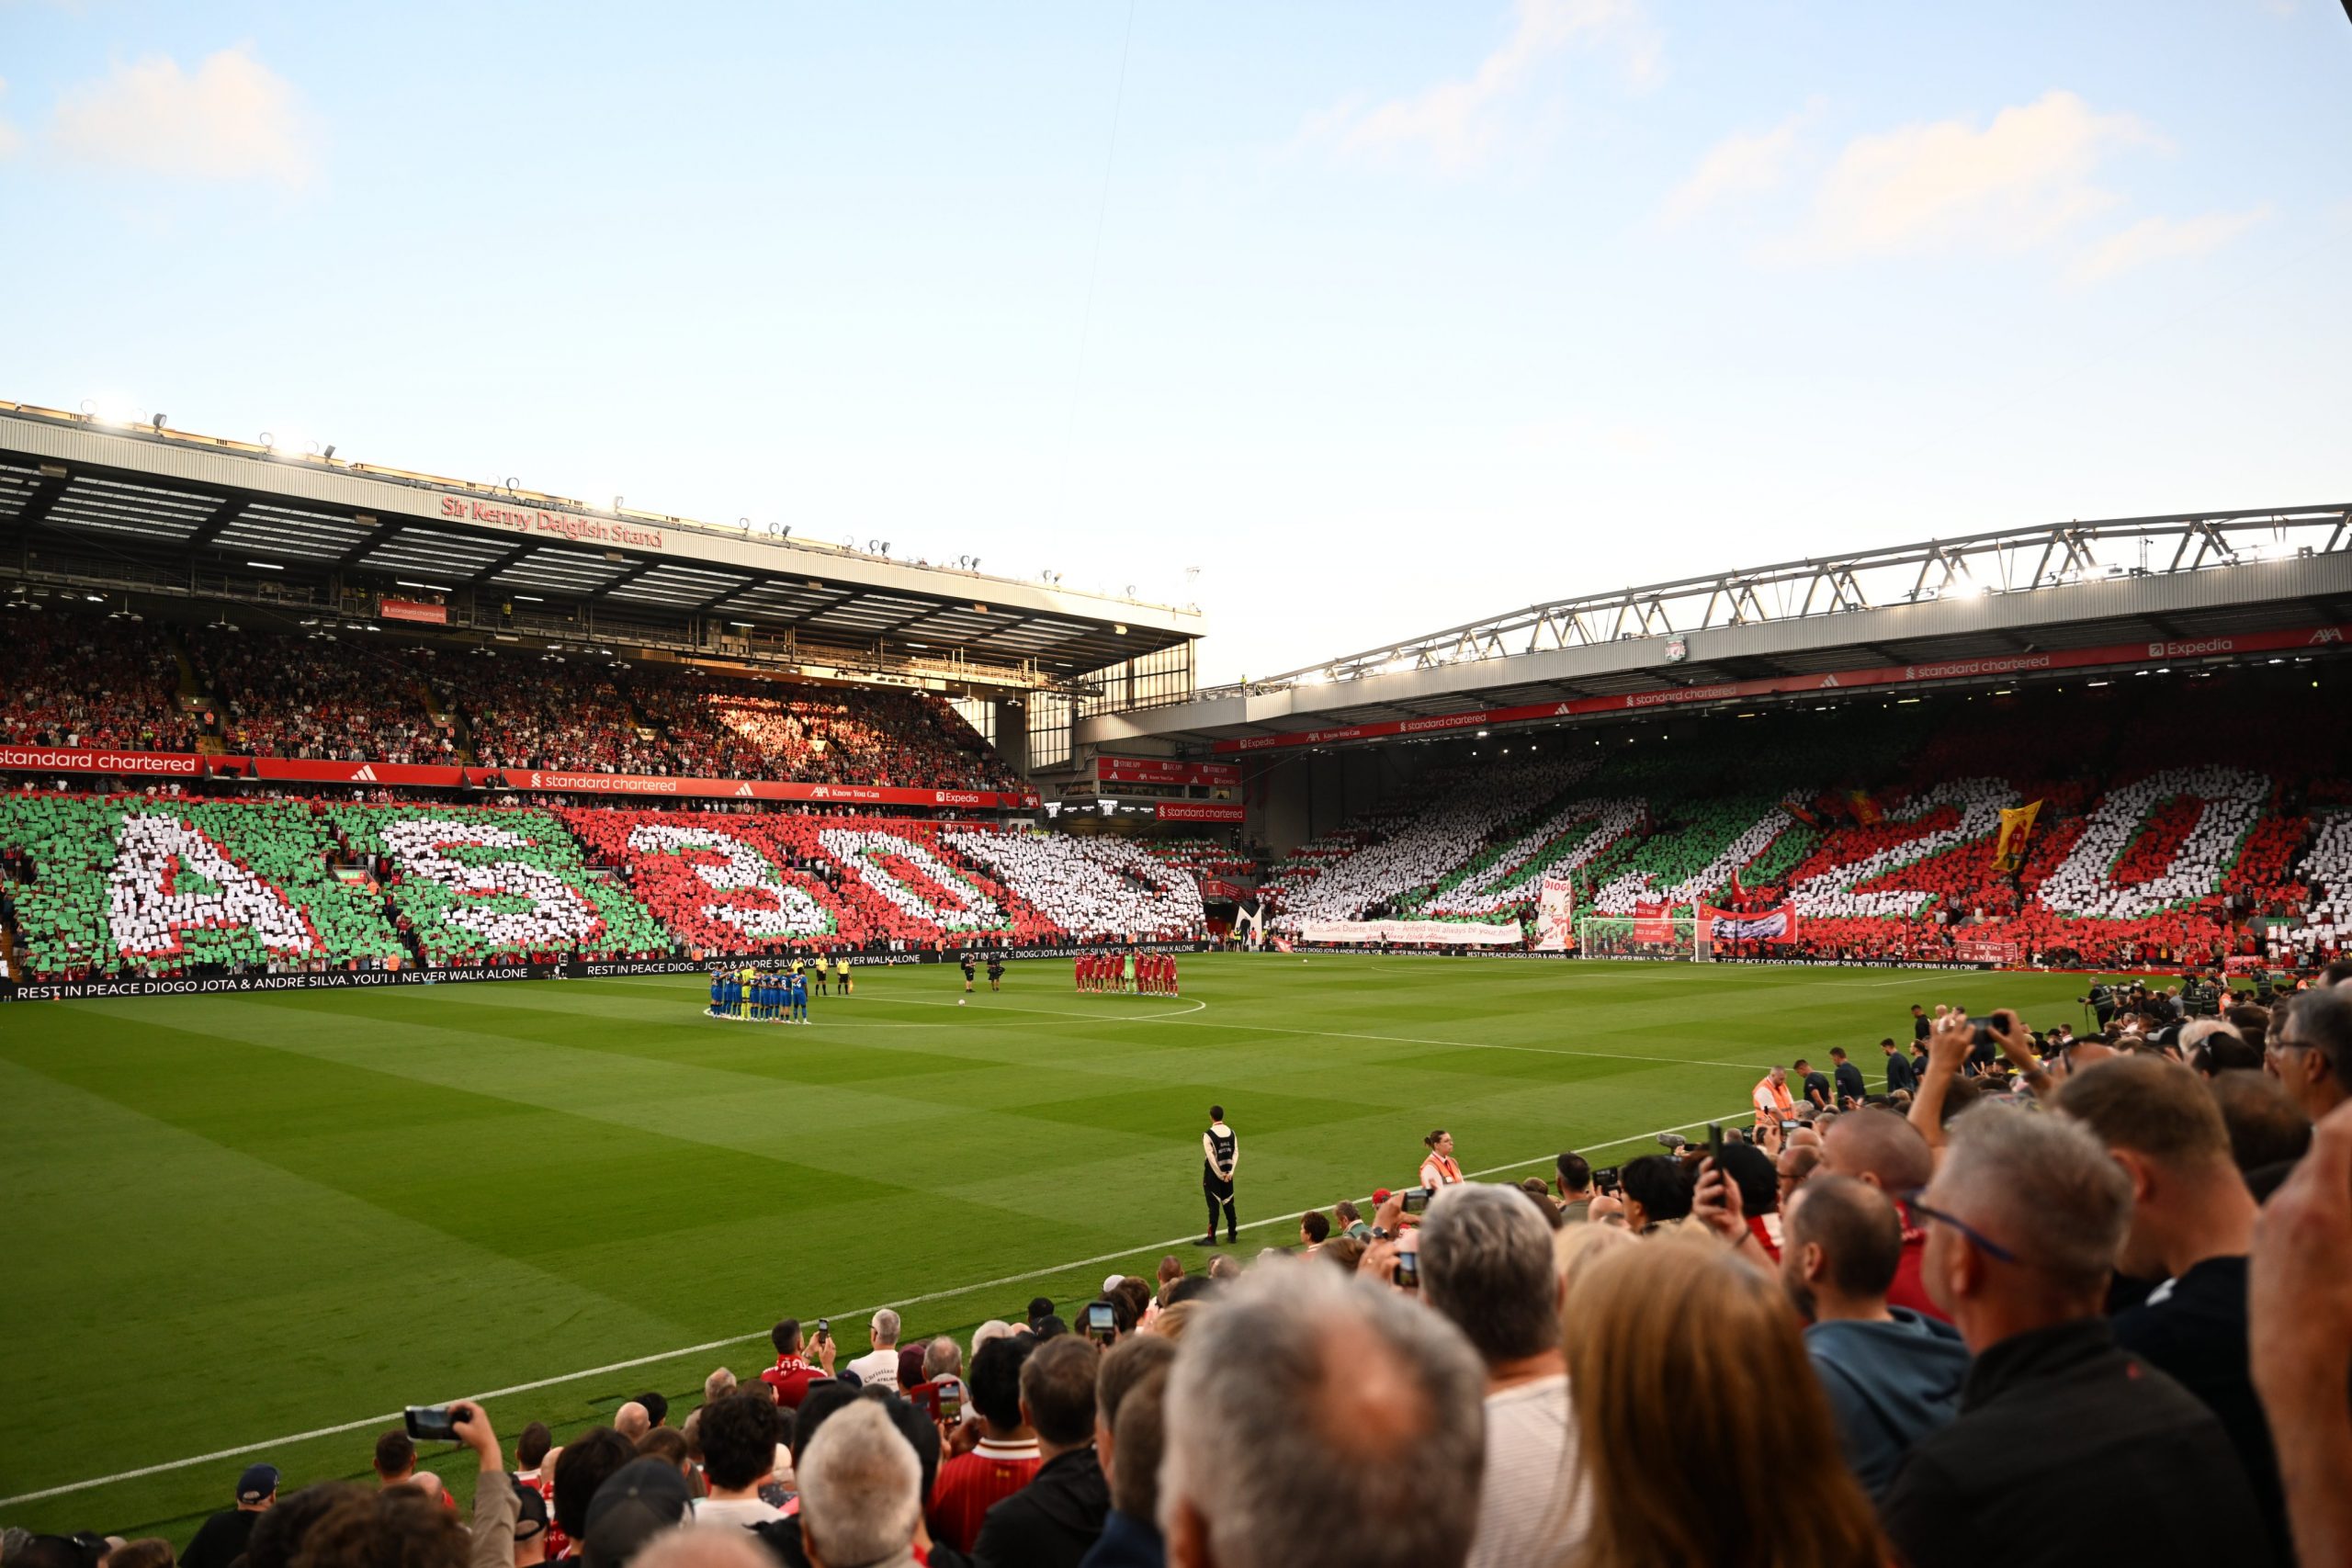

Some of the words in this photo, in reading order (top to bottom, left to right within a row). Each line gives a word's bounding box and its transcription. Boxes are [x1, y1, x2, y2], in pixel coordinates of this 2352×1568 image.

[442, 496, 468, 517] Sir
[472, 501, 533, 532] Kenny
[537, 511, 609, 540] Dalglish
[611, 524, 662, 548] Stand
[2309, 627, 2343, 644] AXA
[2167, 638, 2233, 656] Expedia
[1918, 662, 1978, 678] standard
[1981, 655, 2050, 671] chartered
[1635, 689, 1682, 705] standard
[1684, 685, 1736, 702] chartered
[1408, 717, 1444, 731] standard
[1445, 713, 1487, 727] chartered
[1248, 739, 1275, 749] Expedia
[97, 751, 196, 773] chartered
[545, 775, 610, 791] standard
[612, 777, 676, 793] chartered
[810, 786, 830, 797] AXA
[831, 789, 852, 797] Know
[853, 789, 867, 797] You
[867, 790, 879, 798] Can
[945, 793, 978, 804] Expedia
[1024, 796, 1038, 806] AXA
[1167, 807, 1204, 818] standard
[1205, 808, 1243, 818] chartered
[1040, 949, 1057, 958] JOTA
[1058, 948, 1065, 957] &
[1174, 944, 1195, 953] ALONE
[587, 964, 616, 976] REST
[617, 964, 628, 975] IN
[630, 963, 665, 974] PEACE
[729, 961, 737, 970] &
[866, 955, 891, 964] WALK
[892, 953, 921, 964] ALONE
[17, 986, 62, 999] REST
[64, 986, 82, 997] IN
[87, 983, 141, 996] PEACE
[144, 980, 198, 994] DIOGO
[200, 979, 237, 992] JOTA
[240, 978, 251, 989] &
[254, 975, 306, 989] ANDRÉ
[309, 975, 350, 987] SILVA.
[402, 971, 447, 983] NEVER
[449, 969, 484, 981] WALK
[486, 968, 528, 979] ALONE
